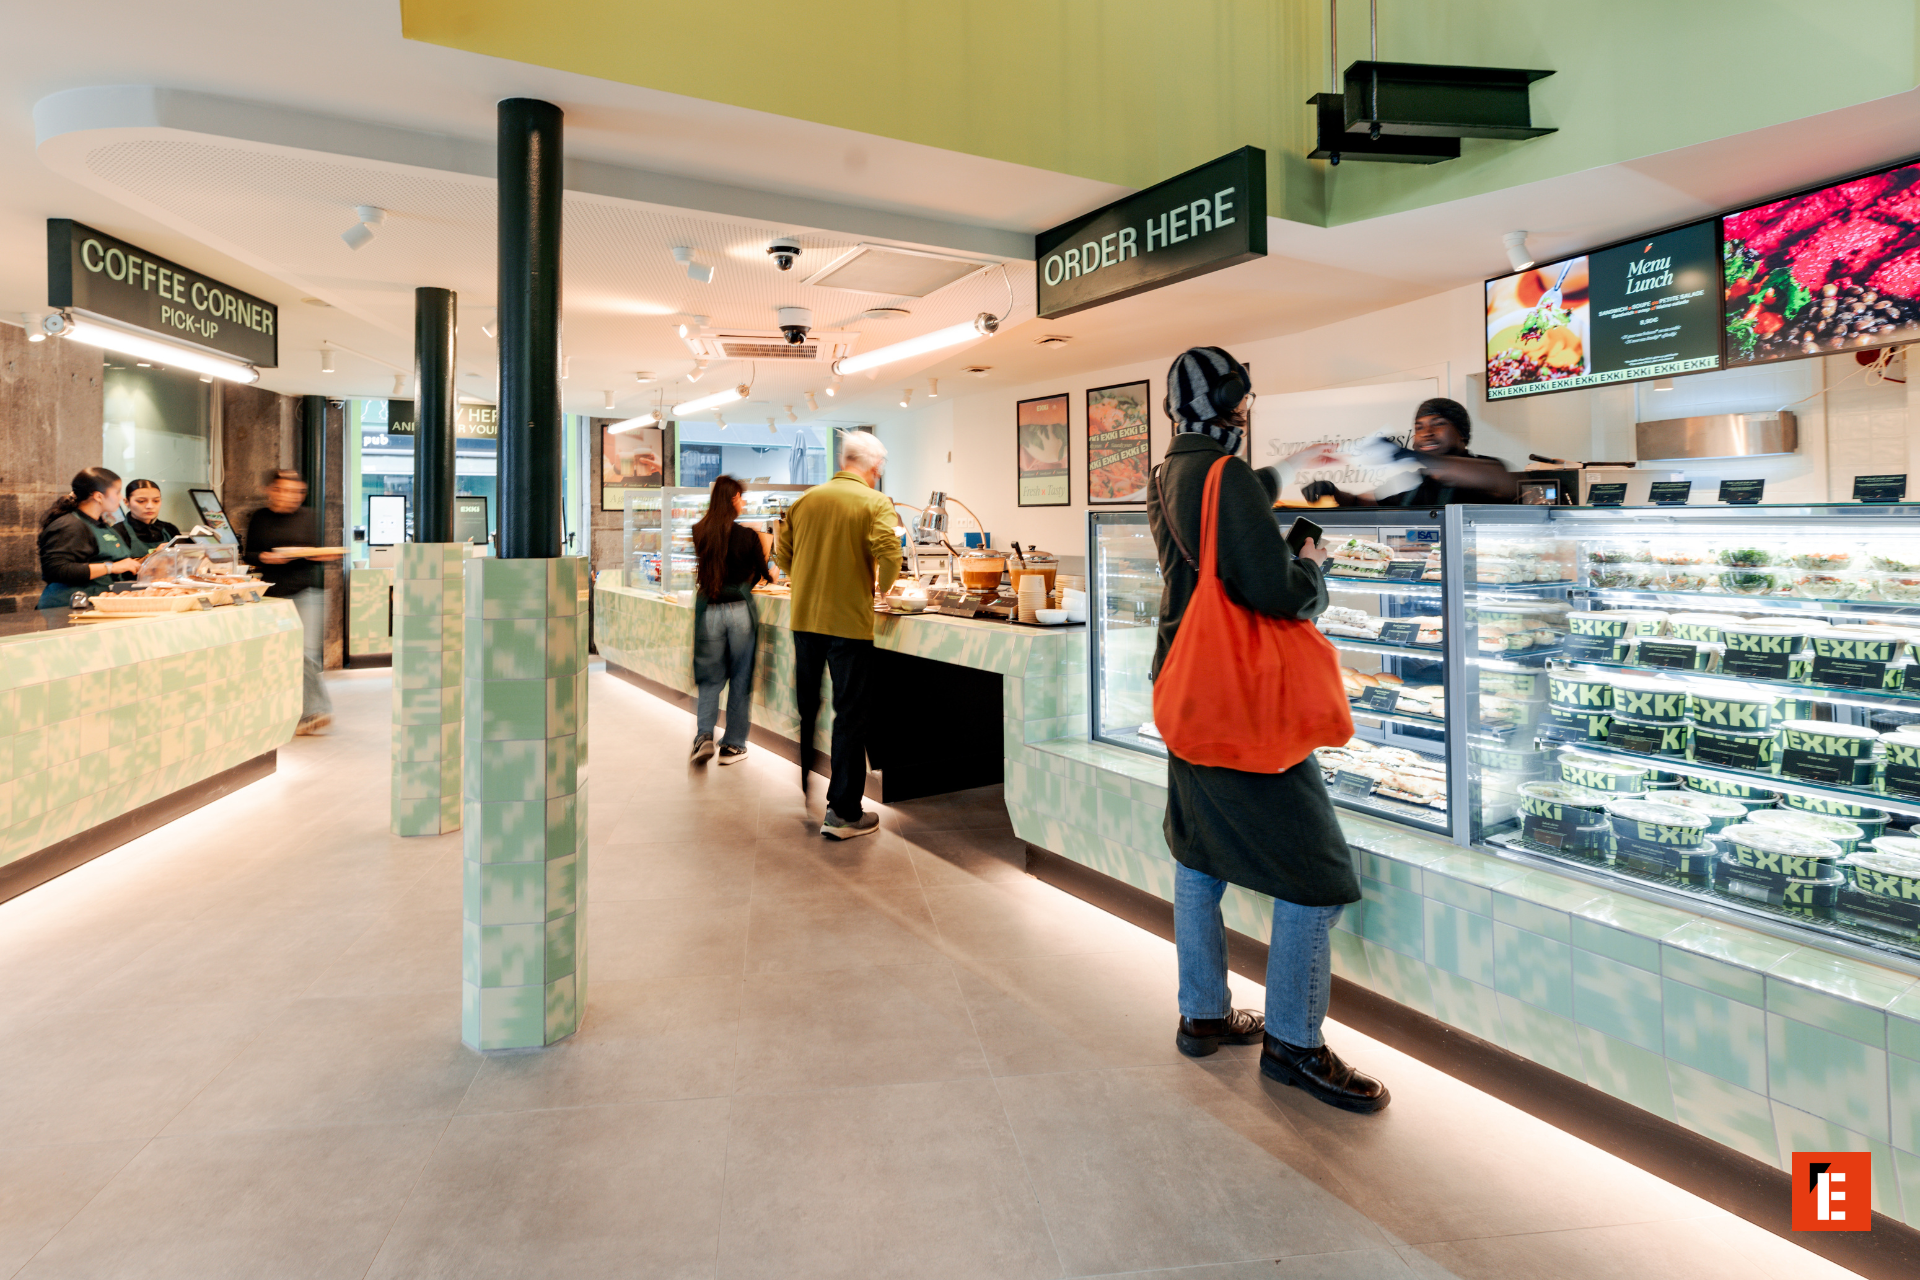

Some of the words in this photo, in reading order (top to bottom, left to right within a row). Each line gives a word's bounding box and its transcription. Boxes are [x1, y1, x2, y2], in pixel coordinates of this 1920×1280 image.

[1044, 227, 1138, 286] ORDER
[1146, 186, 1236, 252] HERE
[1626, 256, 1672, 278] Menu
[81, 238, 186, 304] COFFEE
[191, 282, 274, 335] CORNER
[1625, 269, 1674, 295] Lunch
[161, 305, 219, 339] PICK-UP
[1507, 386, 1527, 395] EXKi
[1529, 382, 1550, 392] EXKi
[1551, 378, 1573, 389] EXKi
[1575, 375, 1598, 386] EXKi
[1600, 371, 1624, 382] EXKi
[1626, 367, 1651, 378] EXKi
[1654, 363, 1680, 375] EXKi
[1683, 359, 1711, 371] EXKi
[363, 433, 389, 447] pub
[1101, 430, 1118, 441] EXKi
[1119, 426, 1138, 438] EXKi
[1266, 434, 1366, 457] Somhing
[1102, 453, 1120, 466] EXKi
[1120, 446, 1140, 459] EXKi
[1312, 464, 1387, 487] cooking
[1023, 485, 1041, 497] Fresh
[1047, 485, 1066, 498] Tasty
[1417, 531, 1433, 540] ISA
[1569, 618, 1622, 638] EXKi
[1726, 632, 1793, 654] EXKi
[1815, 638, 1890, 661] EXKi
[1549, 678, 1612, 706] EXKi
[1613, 686, 1686, 717] EXKi
[1692, 695, 1769, 728] EXKi
[1786, 729, 1860, 757] EXKi
[1884, 742, 1920, 769] EX
[1561, 765, 1616, 791] EXKi
[1637, 820, 1704, 845] EXKi
[1735, 843, 1819, 877] EXKi
